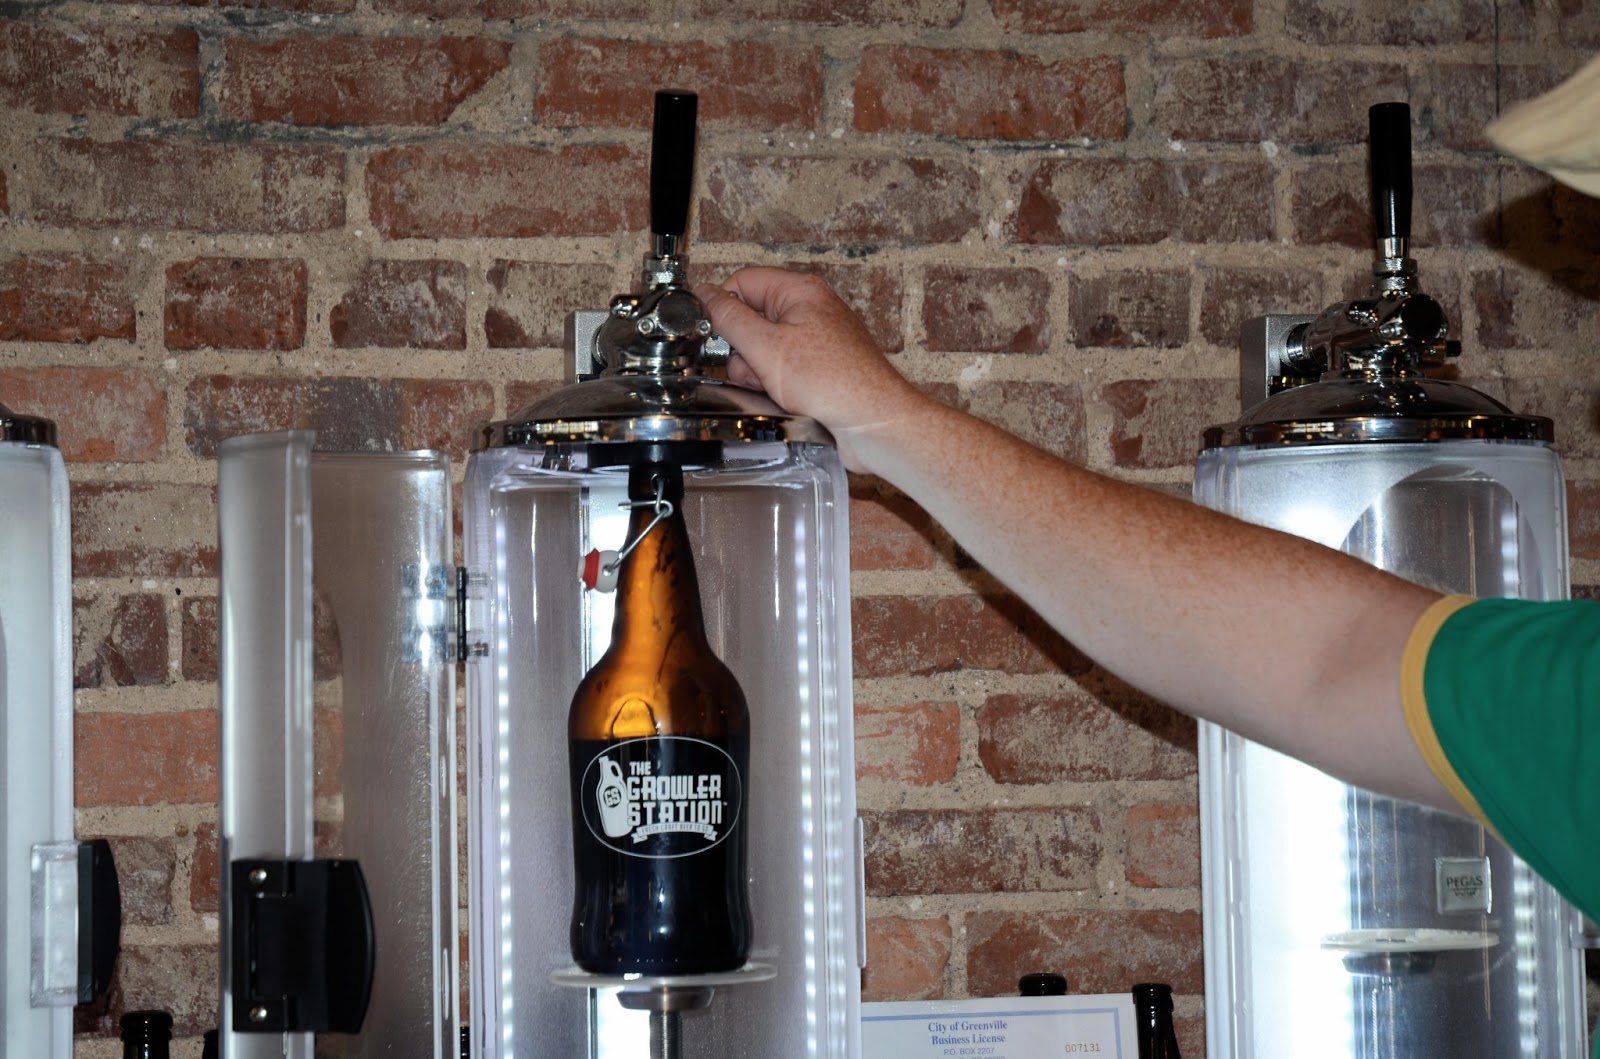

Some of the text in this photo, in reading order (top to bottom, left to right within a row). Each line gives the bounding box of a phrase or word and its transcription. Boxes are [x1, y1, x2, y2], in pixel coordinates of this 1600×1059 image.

[629, 761, 651, 776] THE
[626, 774, 722, 801] GROWLER
[603, 787, 621, 807] GS
[626, 800, 722, 826] STATION
[641, 823, 659, 834] FRESH
[660, 823, 678, 831] CRAFT
[680, 822, 694, 831] BEER
[1446, 875, 1483, 888] PEGAS
[927, 1020, 1008, 1034] City of Greenville
[931, 1034, 1006, 1045] Business License
[943, 1047, 995, 1056] P.O. BOX 2207
[1065, 1043, 1101, 1053] 007131
